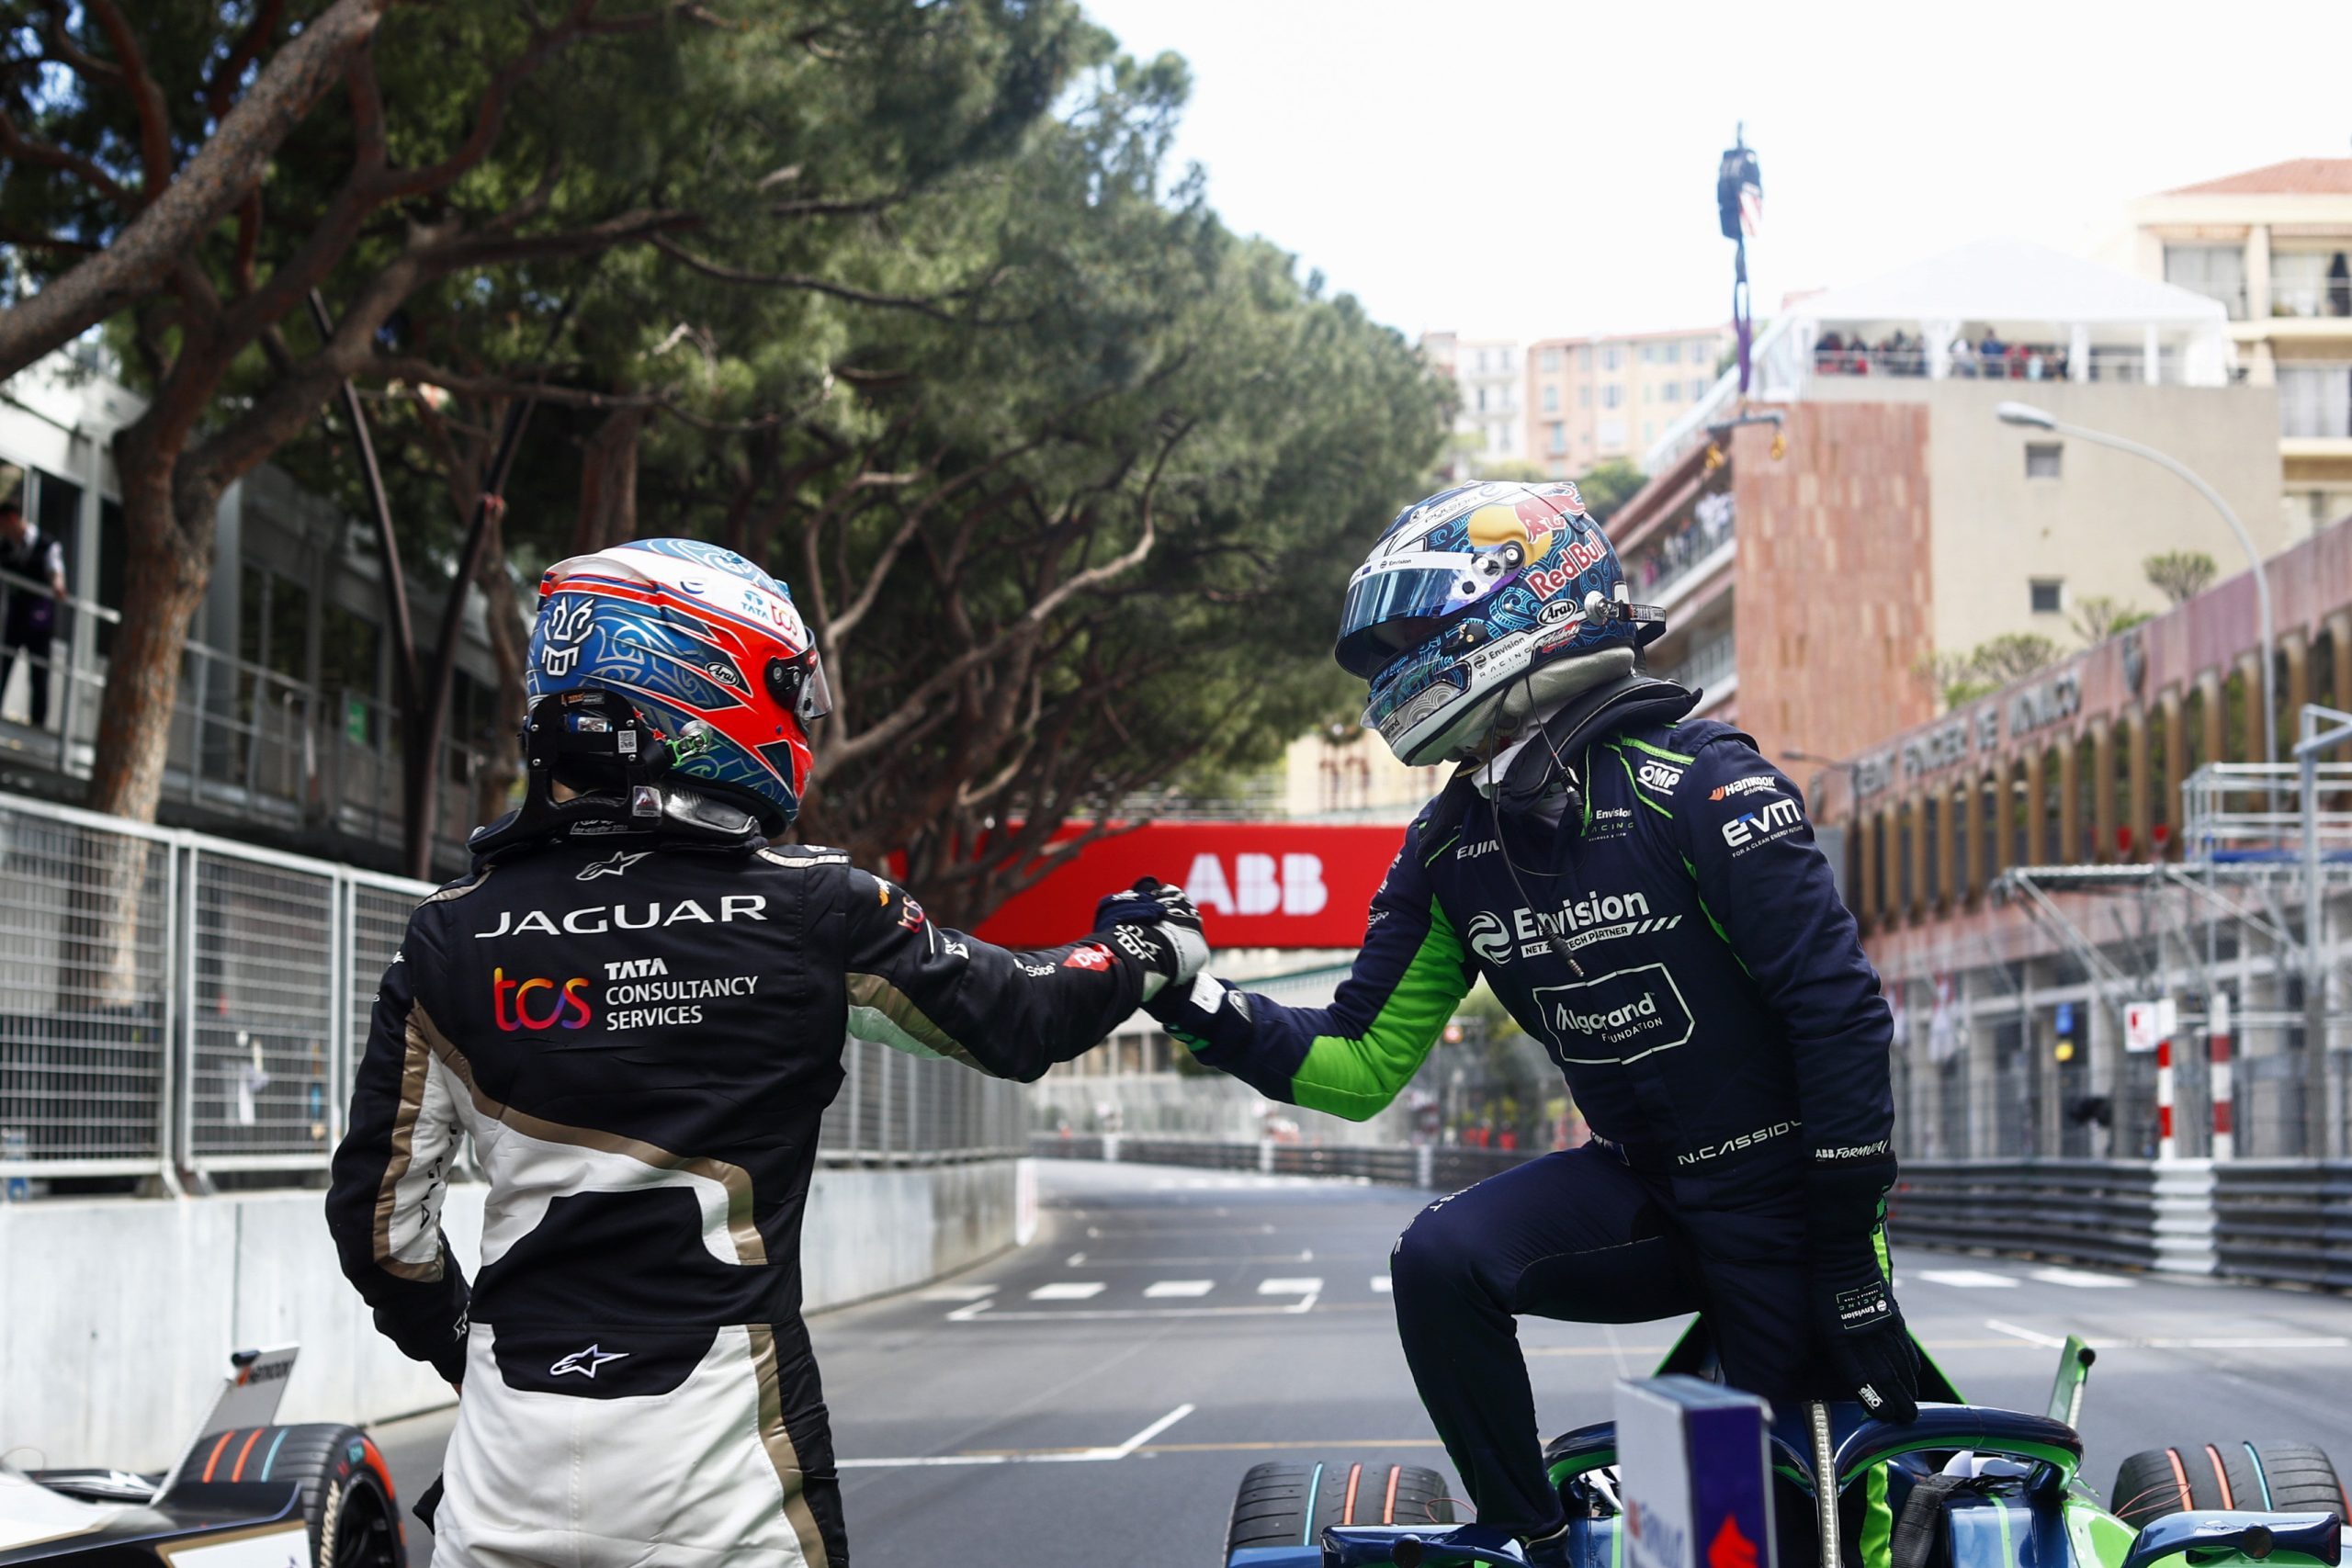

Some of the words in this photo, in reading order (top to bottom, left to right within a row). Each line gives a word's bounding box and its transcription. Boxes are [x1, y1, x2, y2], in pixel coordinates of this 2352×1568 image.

[1527, 551, 1578, 599] Red
[1570, 530, 1606, 570] Bull
[741, 602, 769, 620] TATA
[1544, 602, 1572, 620] Arai
[1488, 637, 1525, 660] Envision
[707, 666, 736, 682] Arai
[1479, 647, 1532, 678] RACING
[1637, 762, 1682, 791] OMP
[1592, 822, 1634, 832] ACING
[1732, 849, 1745, 858] FOR
[1750, 838, 1770, 849] CLEAN
[1770, 829, 1789, 840] ENERGY
[1183, 852, 1329, 916] ABB
[475, 895, 767, 939] JAGUAR
[1513, 891, 1650, 941] Envision
[1525, 944, 1543, 955] NET
[604, 957, 668, 981] TATA
[493, 967, 592, 1032] tcs
[605, 976, 758, 1006] CONSULTANCY
[606, 1005, 703, 1031] SERVICES
[1556, 992, 1656, 1035] Algorand
[1601, 1017, 1663, 1043] FUNDATION
[1815, 1148, 1835, 1158] ABB
[1840, 1305, 1875, 1320] Envision
